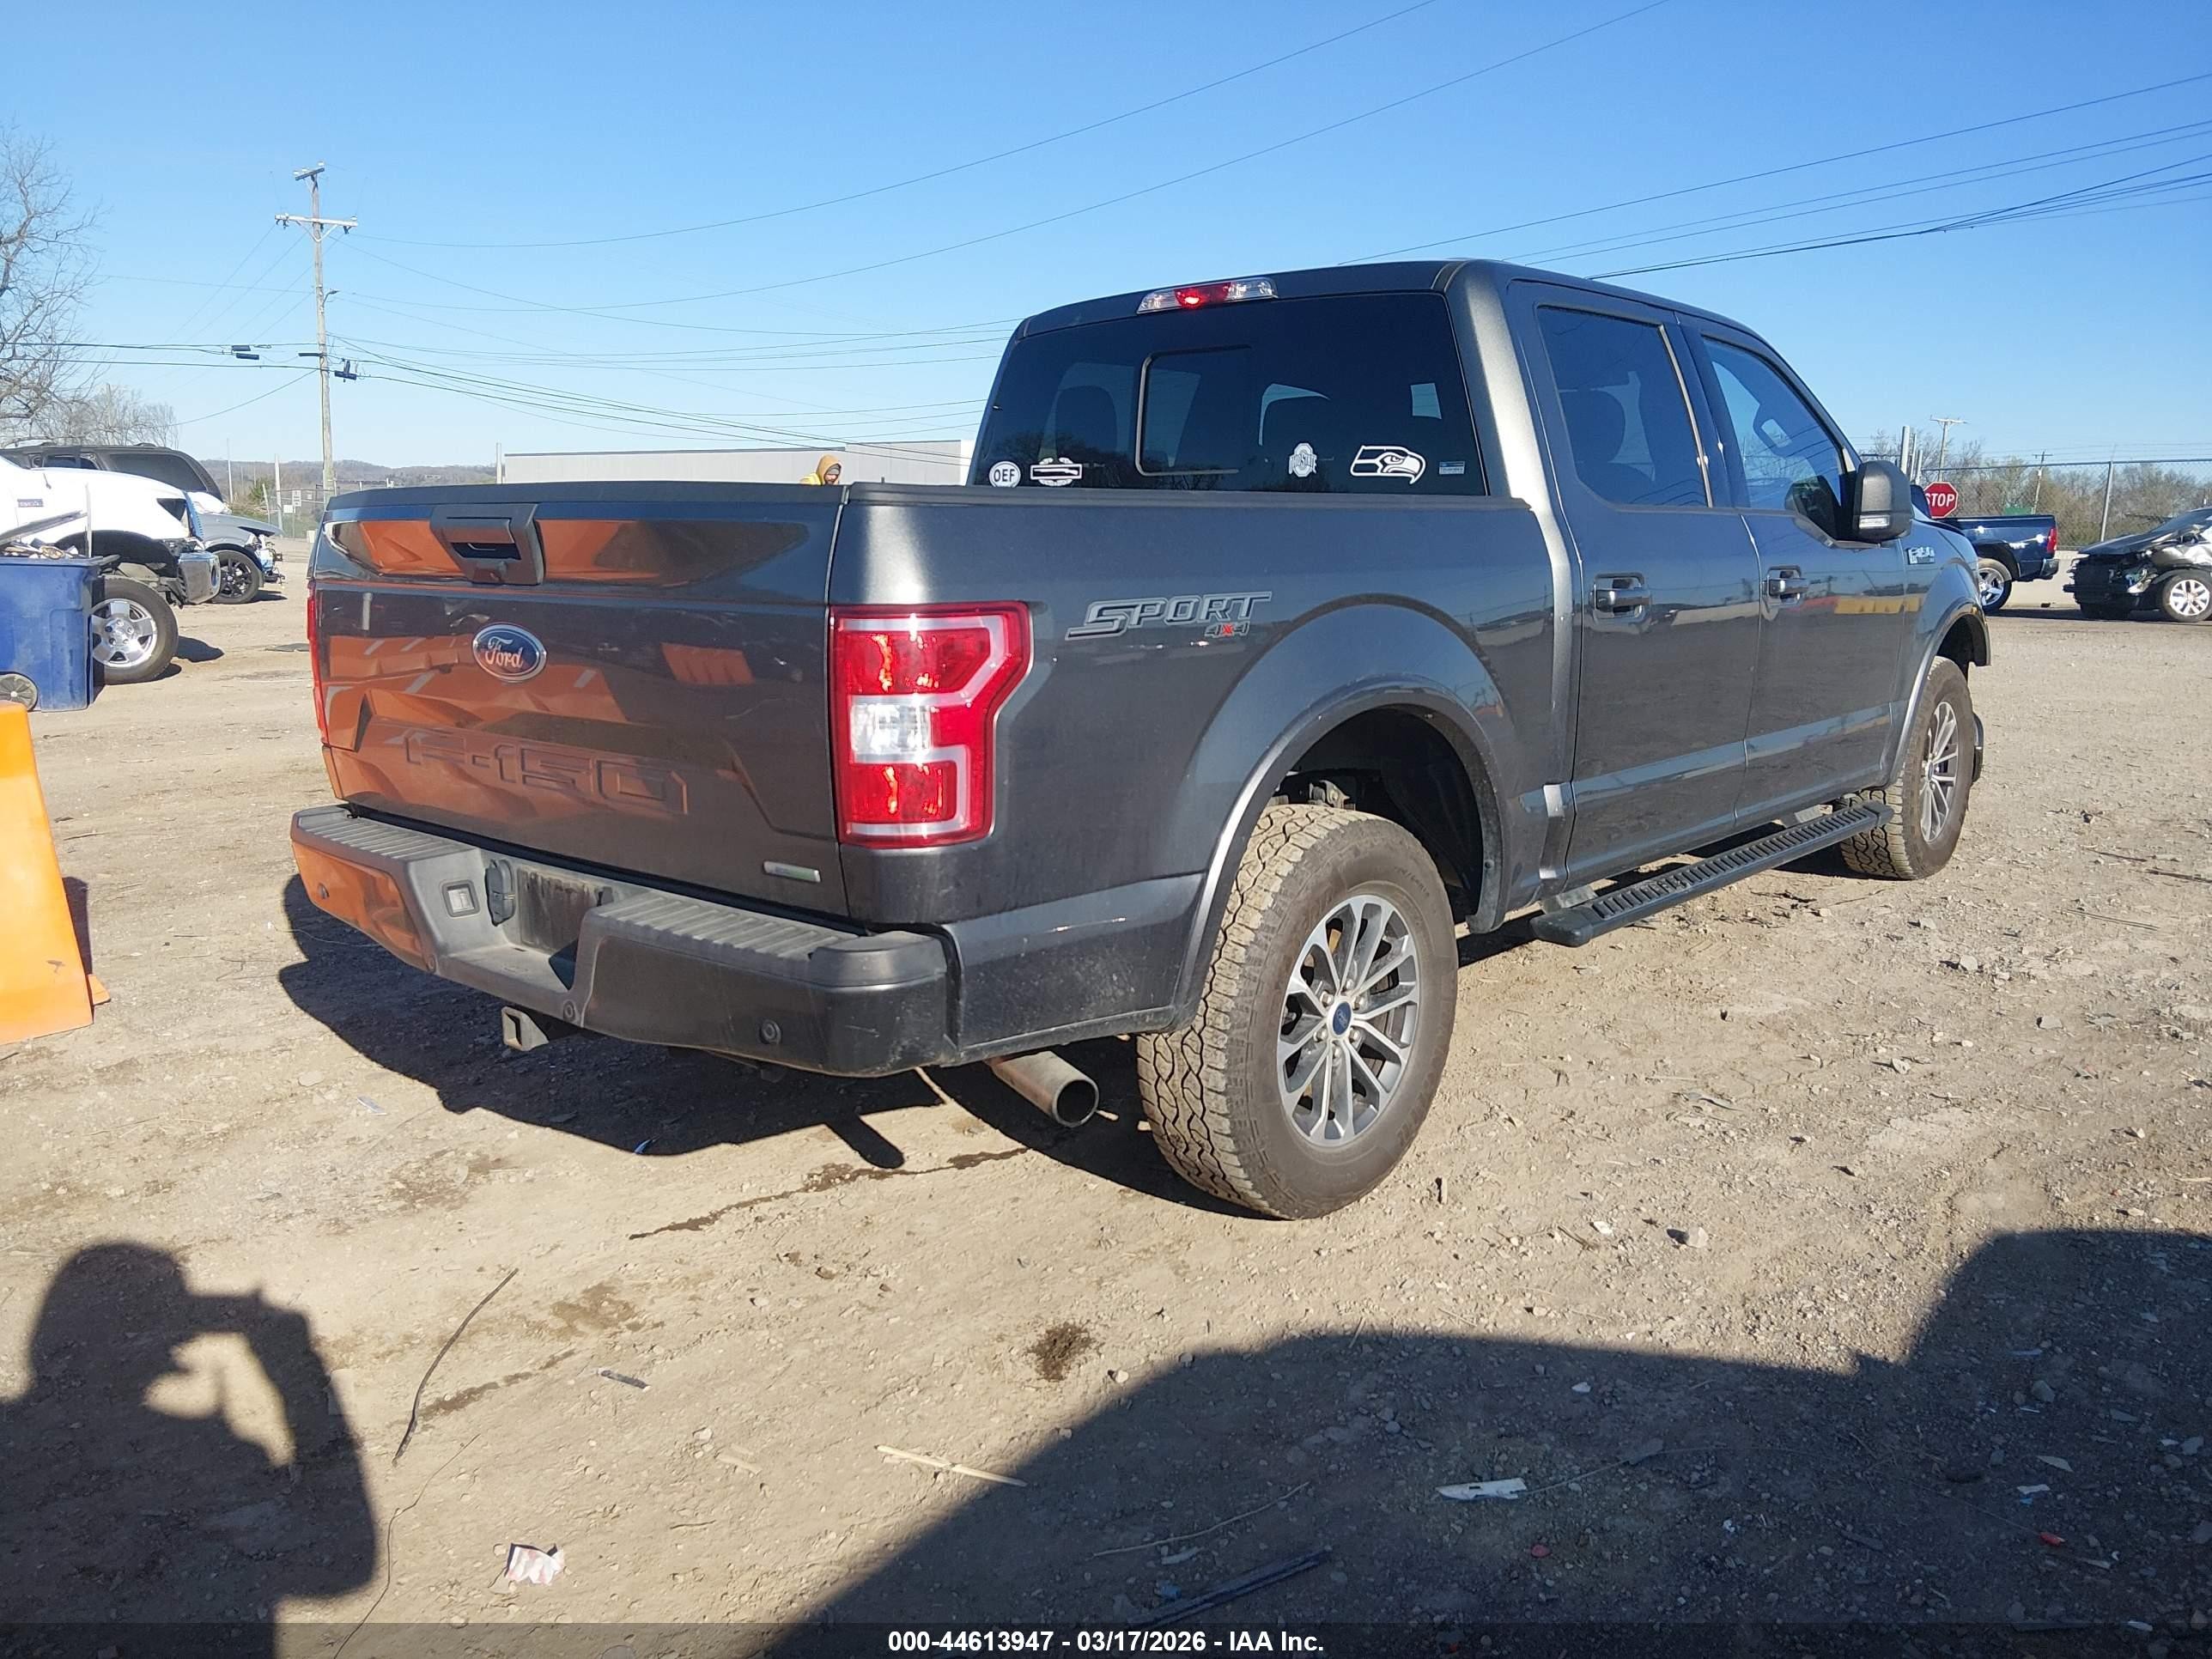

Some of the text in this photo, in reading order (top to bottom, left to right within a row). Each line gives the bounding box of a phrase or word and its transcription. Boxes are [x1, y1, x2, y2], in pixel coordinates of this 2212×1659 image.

[994, 469, 1016, 483] OEF
[1065, 592, 1273, 641] SPORT
[485, 636, 524, 668] Ford
